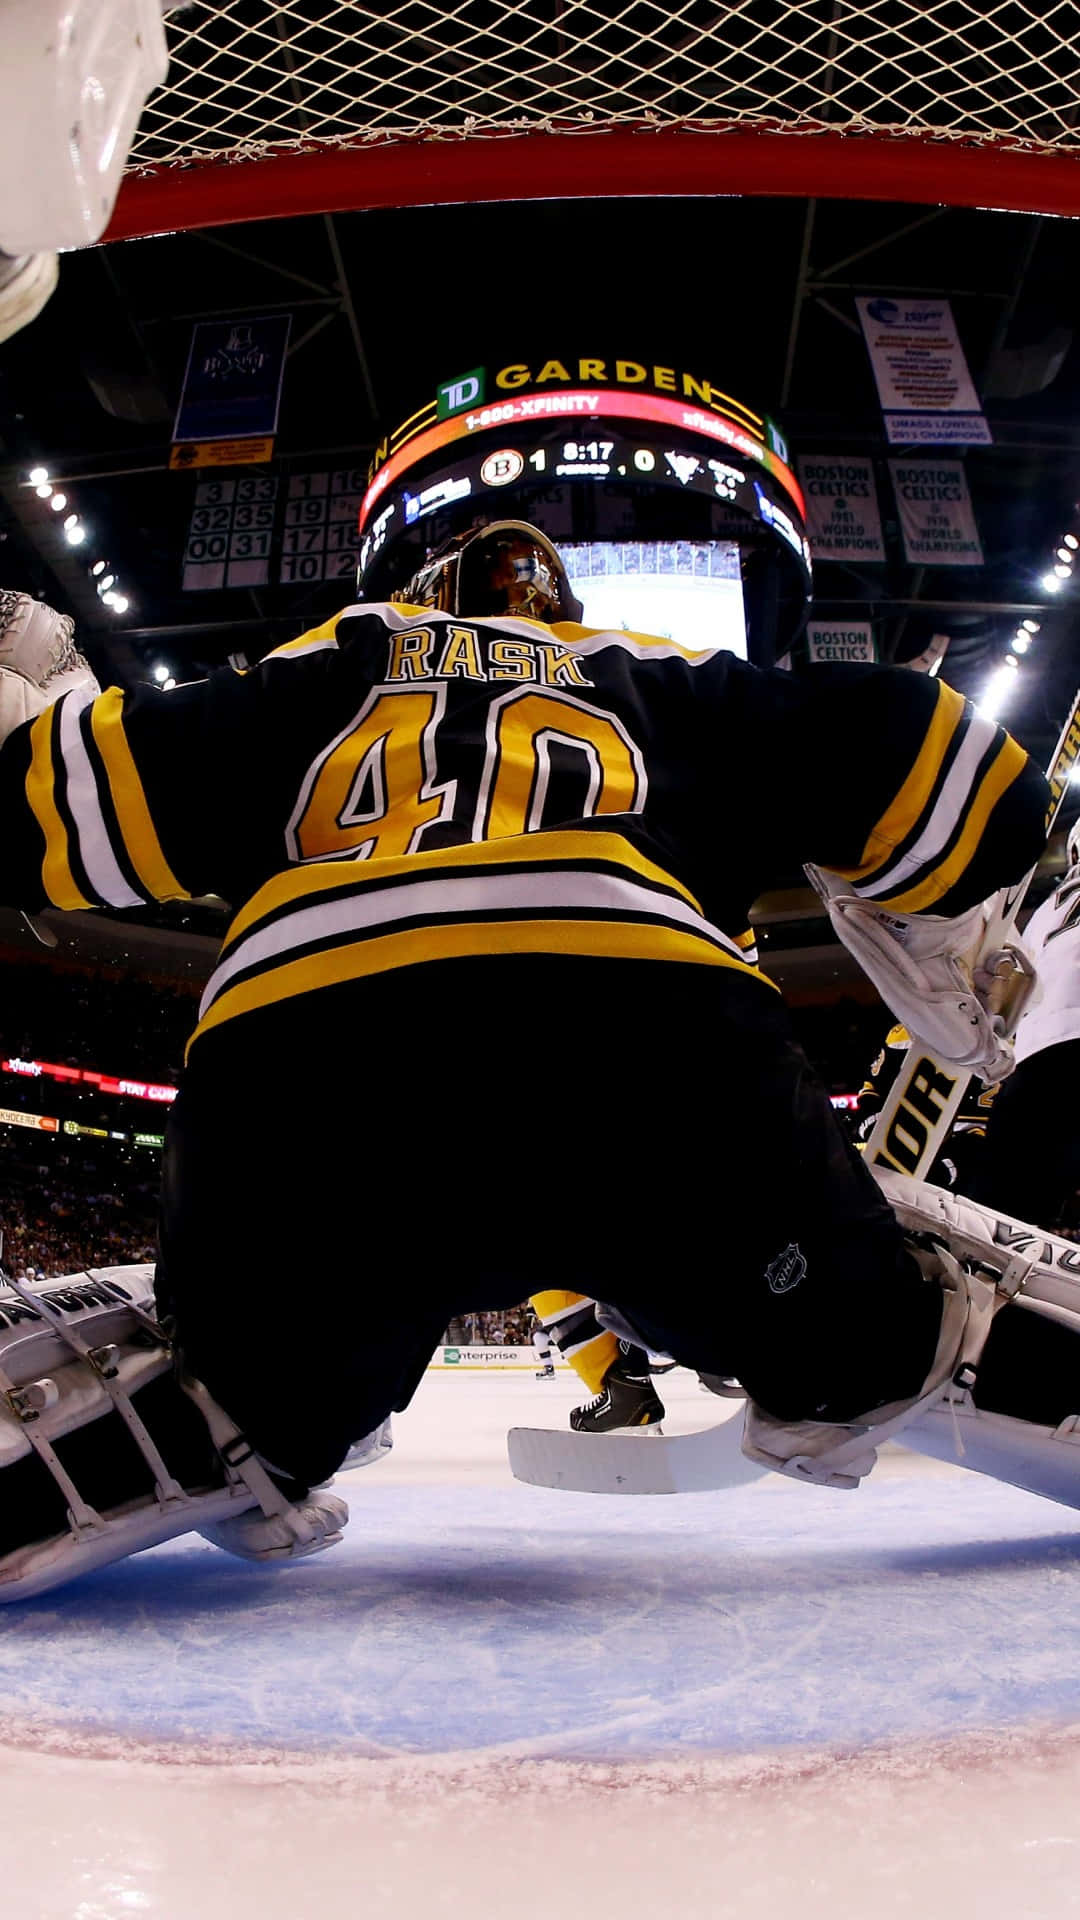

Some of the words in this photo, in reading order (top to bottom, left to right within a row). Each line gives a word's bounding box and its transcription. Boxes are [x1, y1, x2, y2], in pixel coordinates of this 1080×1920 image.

[441, 377, 480, 410] TD
[495, 358, 712, 403] GARDEN
[465, 395, 599, 430] 1-800-XFINITY
[892, 419, 933, 429] UMASS
[935, 420, 982, 430] LOWELL
[682, 411, 765, 460] xfinity.com
[920, 431, 988, 441] CHAMPIONS
[529, 448, 546, 472] 1
[562, 441, 614, 461] 8:17
[634, 449, 656, 472] 0
[805, 466, 869, 481] BOSTON
[896, 469, 961, 484] BOSTON
[208, 483, 222, 504] 3
[241, 479, 276, 501] 33
[807, 481, 870, 497] CELTICS
[902, 486, 962, 501] CELTICS
[194, 508, 229, 531] 32
[236, 505, 273, 527] 35
[292, 501, 322, 523] 19
[287, 529, 321, 551] 17
[823, 524, 865, 536] WORLD
[919, 528, 961, 539] WORLD
[189, 537, 226, 559] 00
[236, 534, 268, 556] 31
[810, 536, 880, 550] CHAMPIONS
[909, 540, 978, 552] CHAMPIONS
[284, 557, 318, 580] 10
[813, 631, 868, 646] BOSTON
[384, 625, 594, 687] RASK
[816, 646, 868, 661] CELTICS
[284, 682, 648, 861] 40
[8, 1057, 42, 1077] xfinity
